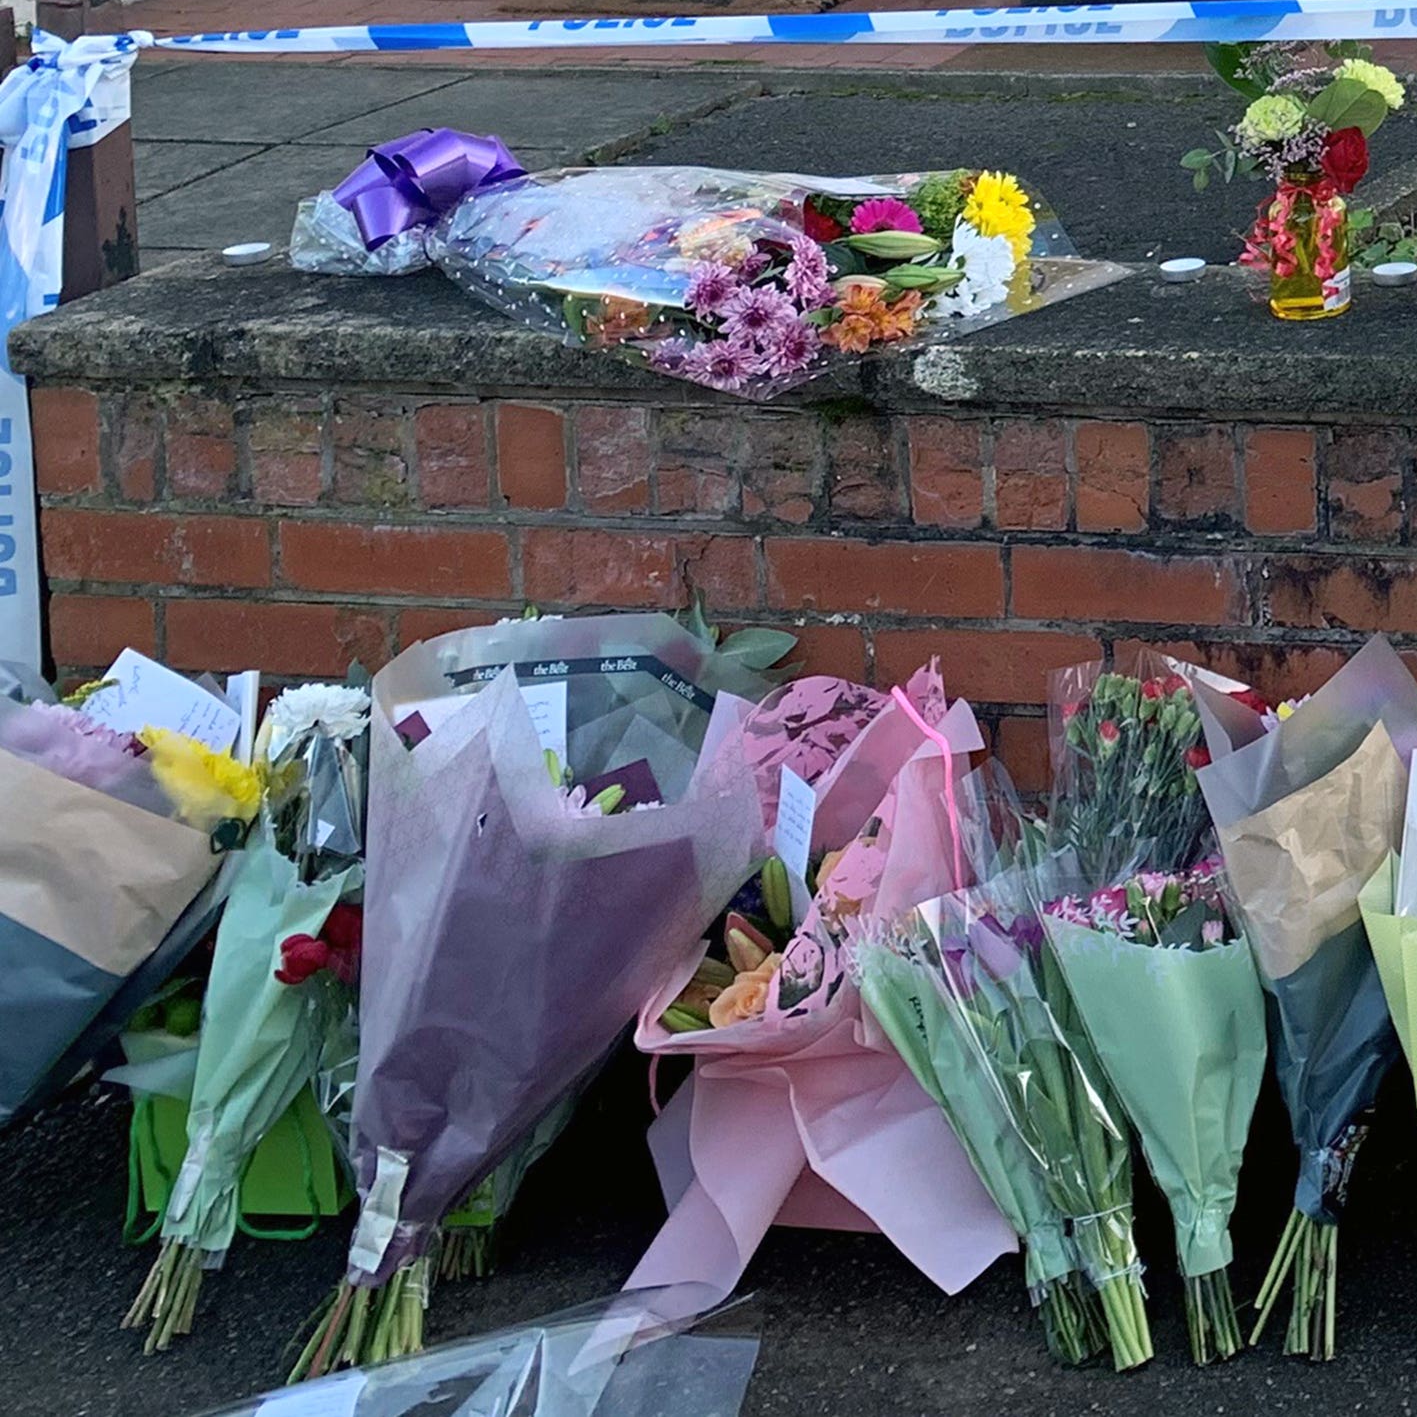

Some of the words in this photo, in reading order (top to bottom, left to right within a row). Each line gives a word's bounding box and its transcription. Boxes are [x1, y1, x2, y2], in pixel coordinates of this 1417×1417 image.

[533, 664, 548, 675] the
[601, 660, 615, 672] the
[616, 657, 638, 672] Best
[661, 673, 677, 689] the
